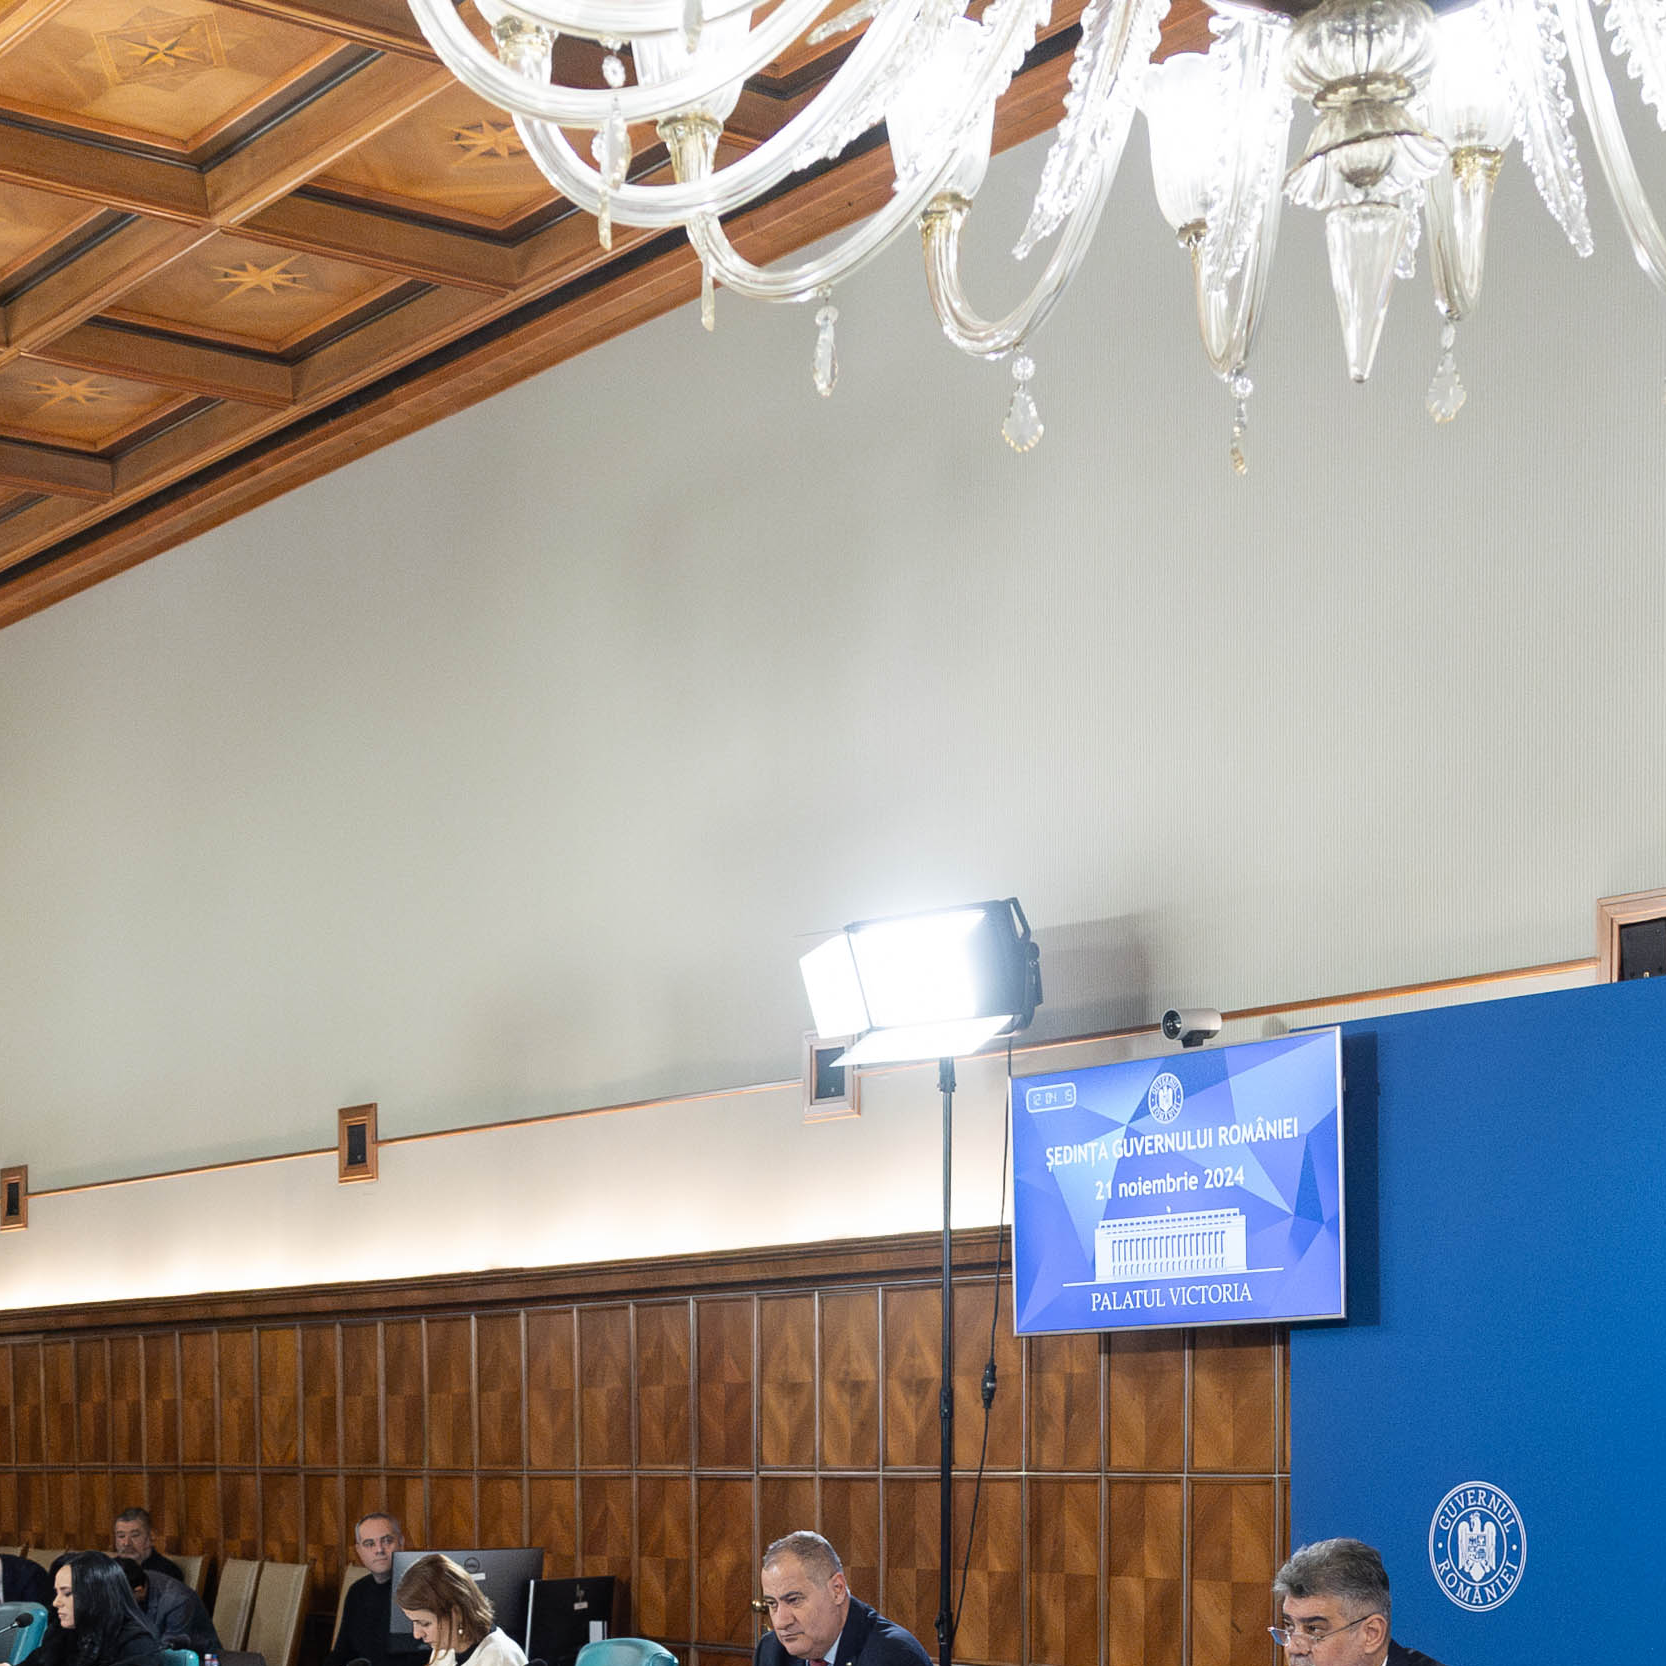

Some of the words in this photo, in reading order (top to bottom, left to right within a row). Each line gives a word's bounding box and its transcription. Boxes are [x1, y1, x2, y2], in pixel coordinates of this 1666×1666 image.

[1112, 1127, 1214, 1159] GUVERNULUI
[1218, 1117, 1299, 1147] ROMÂNIEI
[1095, 1180, 1112, 1201] 21
[1118, 1171, 1199, 1198] noiembrie
[1204, 1166, 1245, 1189] 2024
[1091, 1288, 1166, 1312] PALATUL
[1168, 1282, 1253, 1306] VICTORIA
[1438, 1489, 1516, 1533] GUVERNUL
[1437, 1558, 1518, 1604] ROMÂNIEI
